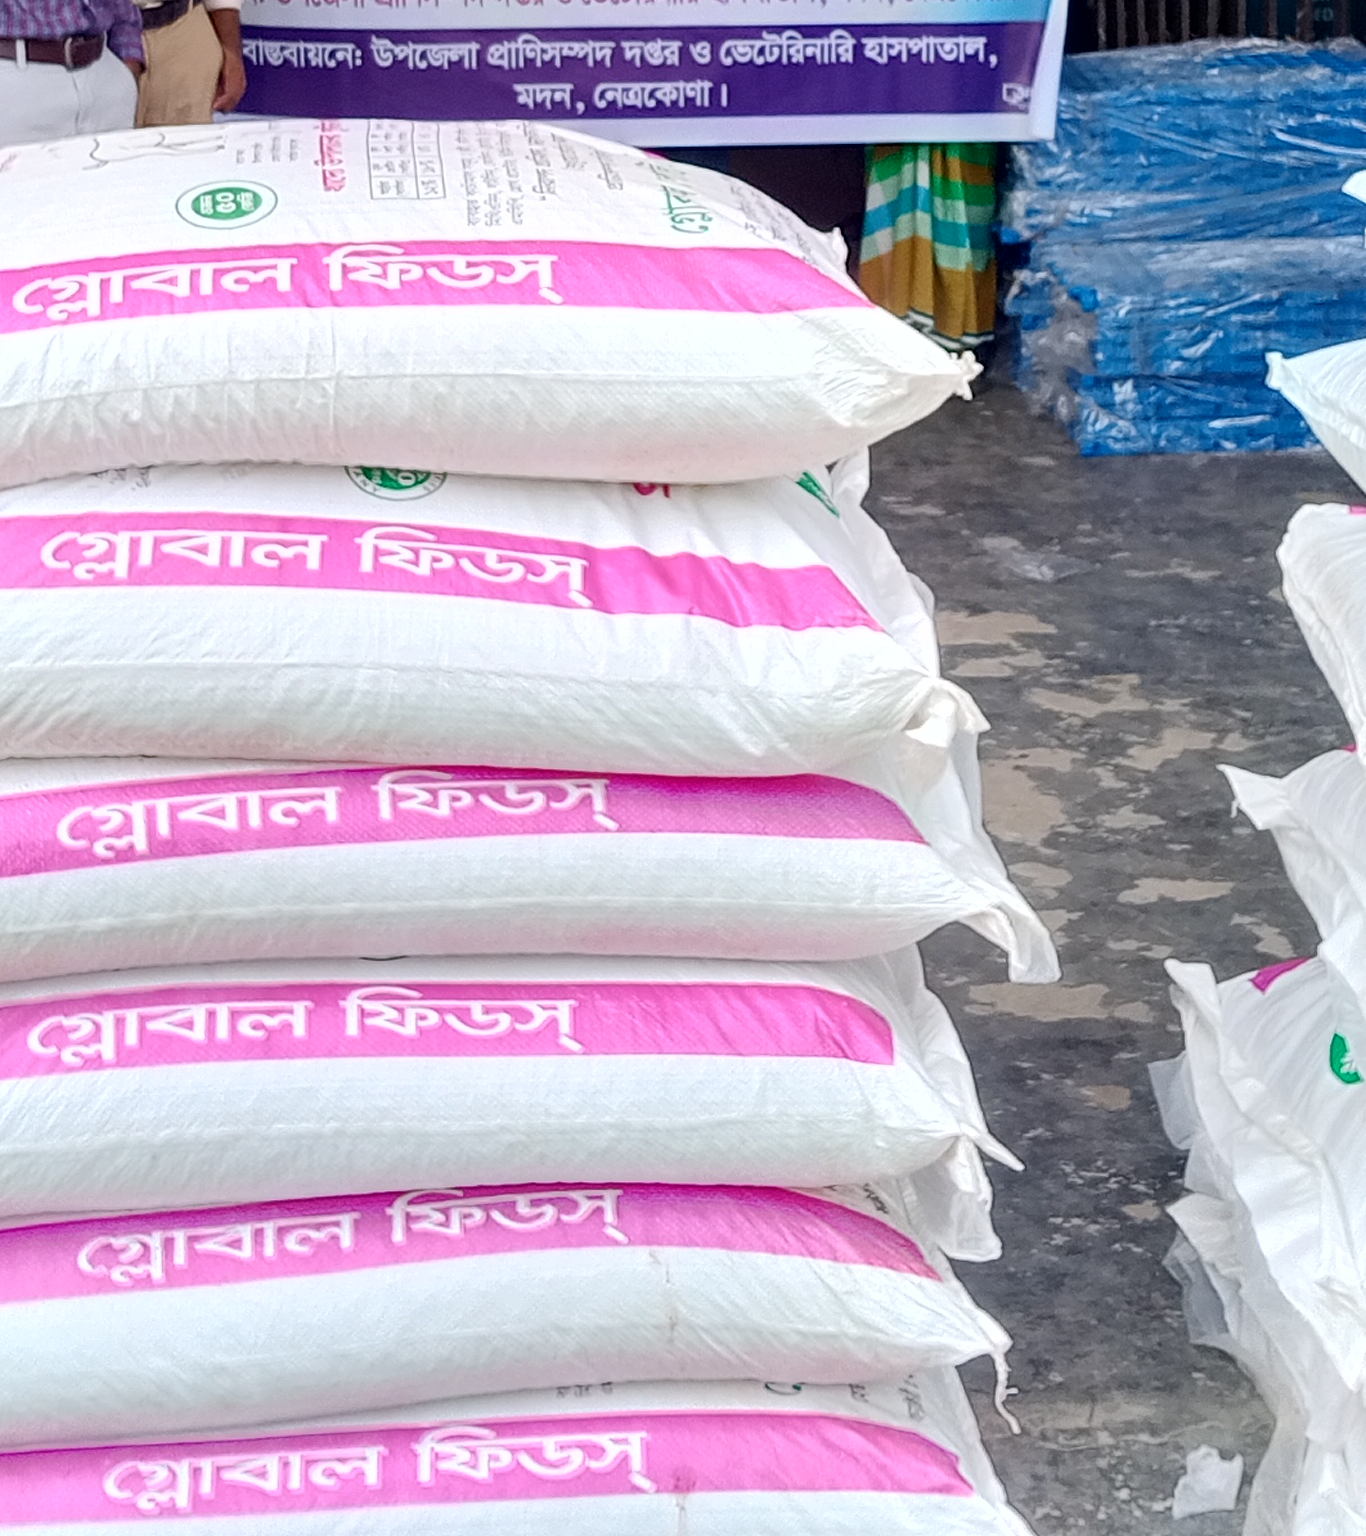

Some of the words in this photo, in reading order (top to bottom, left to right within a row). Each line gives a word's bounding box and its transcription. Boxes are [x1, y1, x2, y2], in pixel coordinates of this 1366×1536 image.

[371, 34, 479, 70] উপজেলা
[488, 34, 614, 69] প্রাণিসম্পদ
[622, 38, 681, 67] দপ্তর
[690, 43, 711, 63] ও
[720, 30, 854, 65] ভেটেরিনারি
[863, 36, 997, 68] হাসপাতাল,
[513, 82, 584, 114] মদন,
[12, 257, 297, 320] গ্লোবাল
[323, 243, 564, 305] ফিডস্
[40, 528, 328, 580] গ্লোবাল
[354, 522, 593, 607] ফিডস্
[56, 784, 341, 860] গ্লোবাল
[372, 770, 619, 830] ফিডস্
[26, 999, 315, 1067] গ্লোবাল
[339, 985, 585, 1053] ফিডস্
[77, 1211, 360, 1286] গ্লোবাল
[386, 1188, 631, 1244] ফিডস্
[102, 1444, 385, 1515] গ্লোবাল
[413, 1425, 657, 1494] ফিডস্
